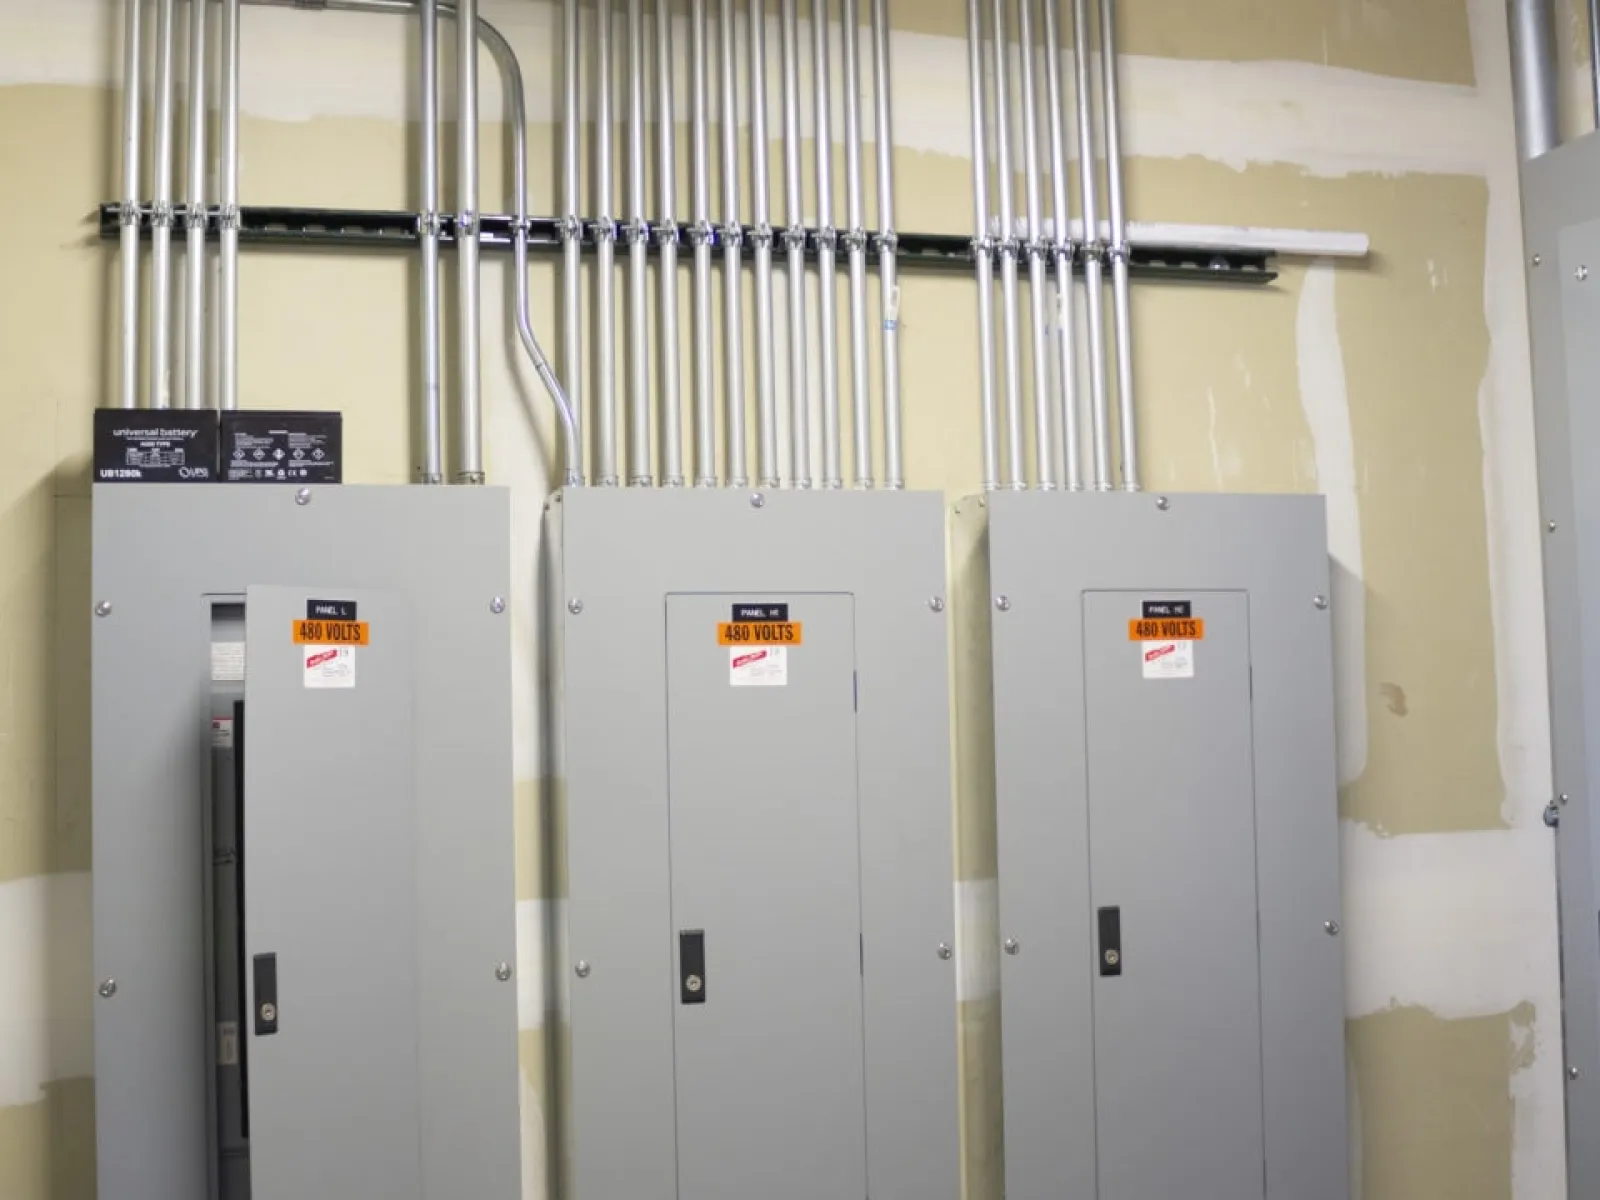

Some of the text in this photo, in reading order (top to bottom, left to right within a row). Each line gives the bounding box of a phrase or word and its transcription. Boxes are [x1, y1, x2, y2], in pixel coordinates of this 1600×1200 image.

[112, 428, 199, 438] universal battery
[315, 605, 347, 615] PANEL L
[741, 608, 766, 617] PANEL
[1149, 605, 1170, 614] PANEL
[300, 622, 361, 641] 480 VOLTS
[725, 624, 793, 641] 480 VOLTS
[1137, 620, 1196, 636] 480 VOLTS
